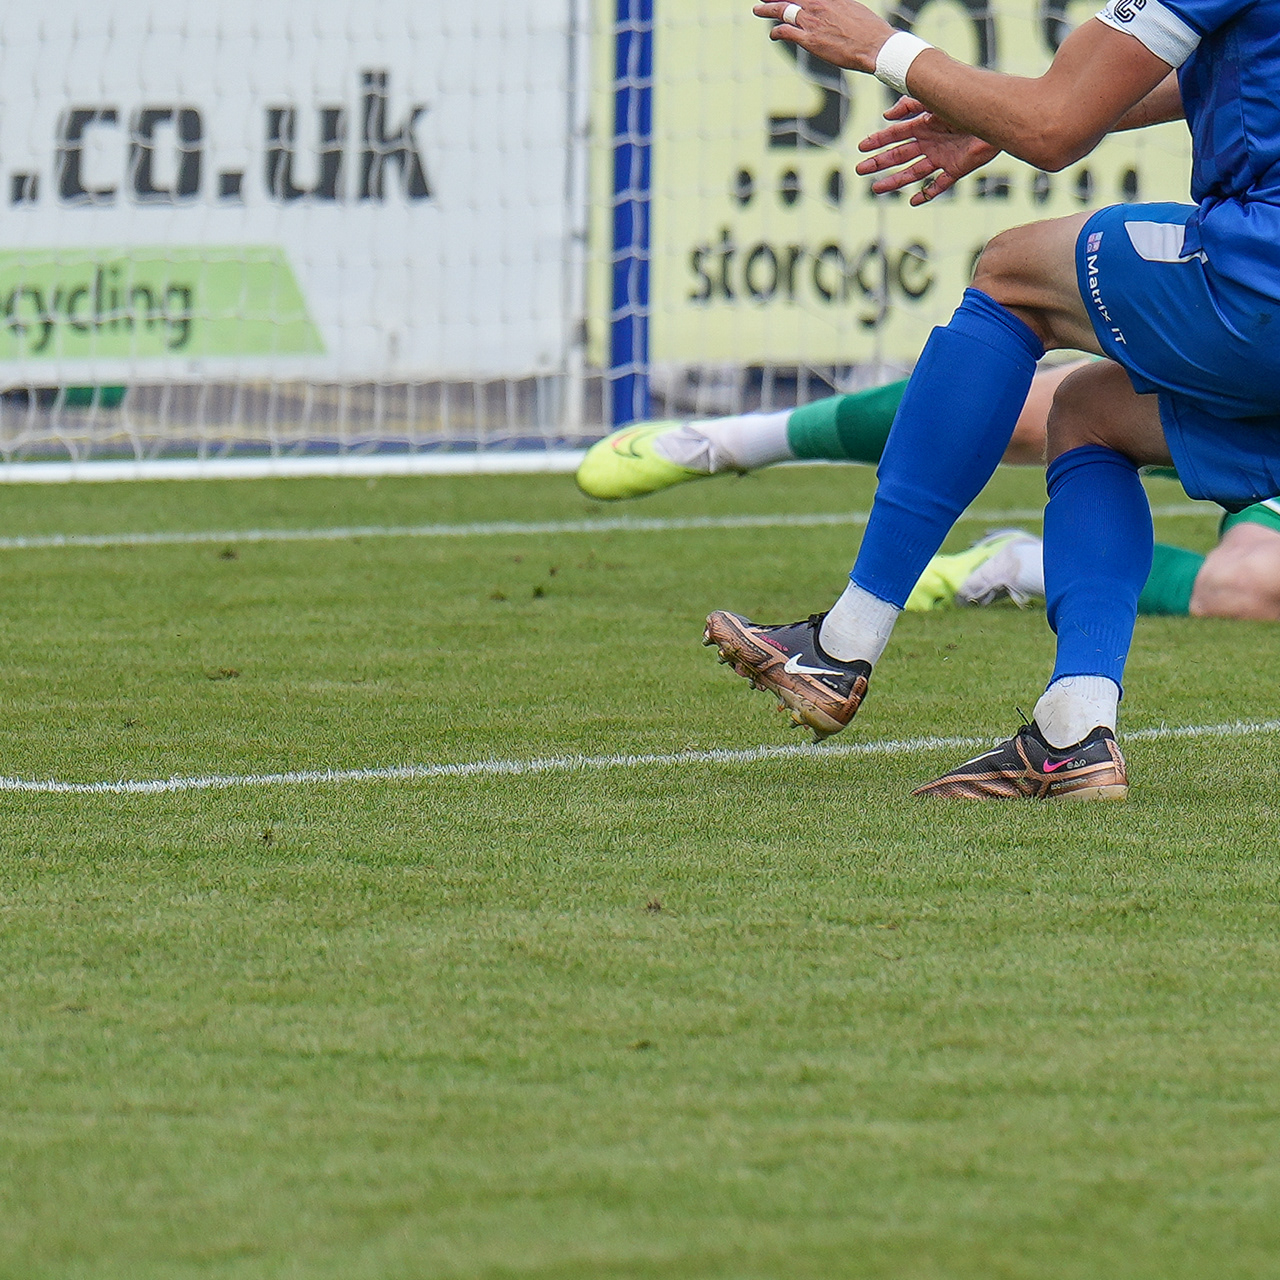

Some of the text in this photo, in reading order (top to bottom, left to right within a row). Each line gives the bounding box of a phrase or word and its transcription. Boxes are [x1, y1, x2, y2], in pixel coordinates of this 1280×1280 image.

[11, 69, 434, 204] .co.uk
[0, 263, 194, 352] cycling
[689, 225, 936, 328] storage
[1086, 254, 1127, 345] Matrix IT
